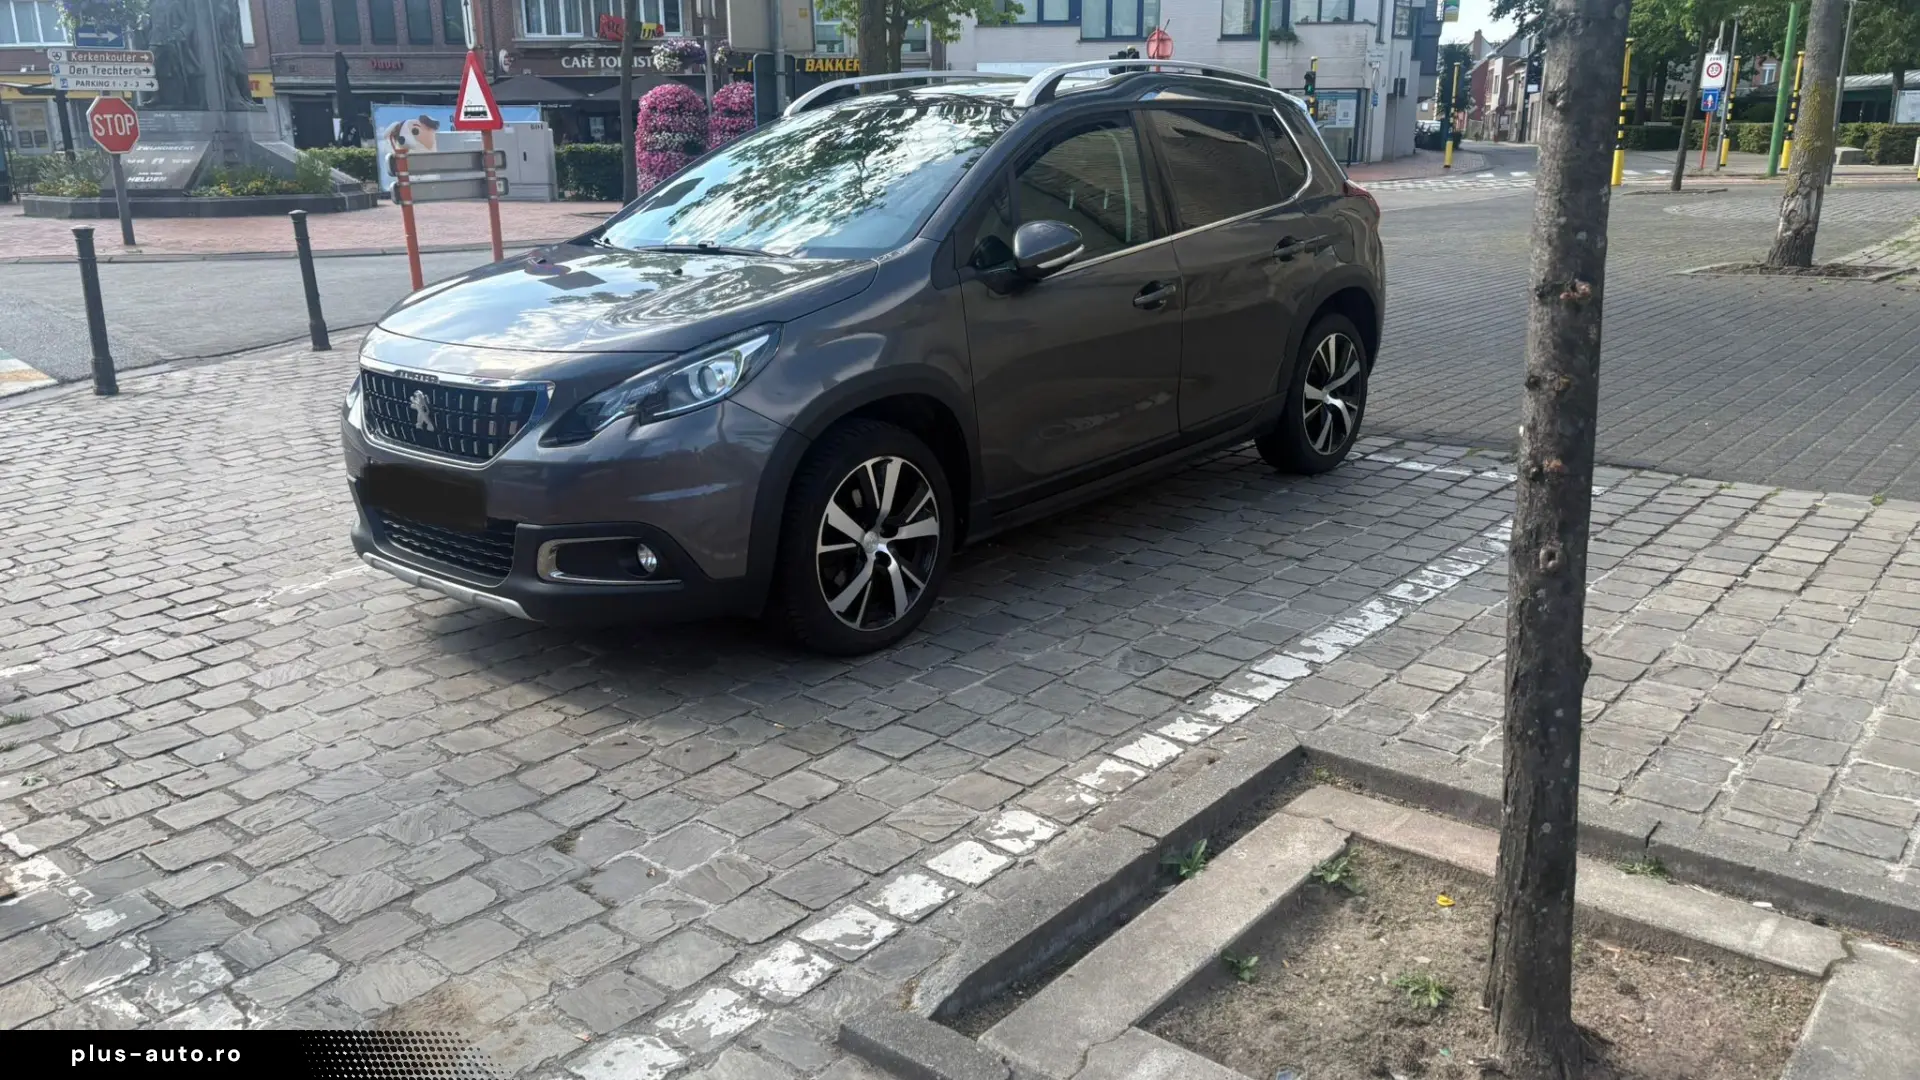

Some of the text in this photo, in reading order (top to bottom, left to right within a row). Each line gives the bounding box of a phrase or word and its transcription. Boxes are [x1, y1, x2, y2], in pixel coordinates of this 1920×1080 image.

[71, 51, 137, 62] Kerkenkouter
[598, 56, 652, 68] TOIST
[69, 65, 135, 76] Den Trechter
[93, 113, 135, 136] STOP
